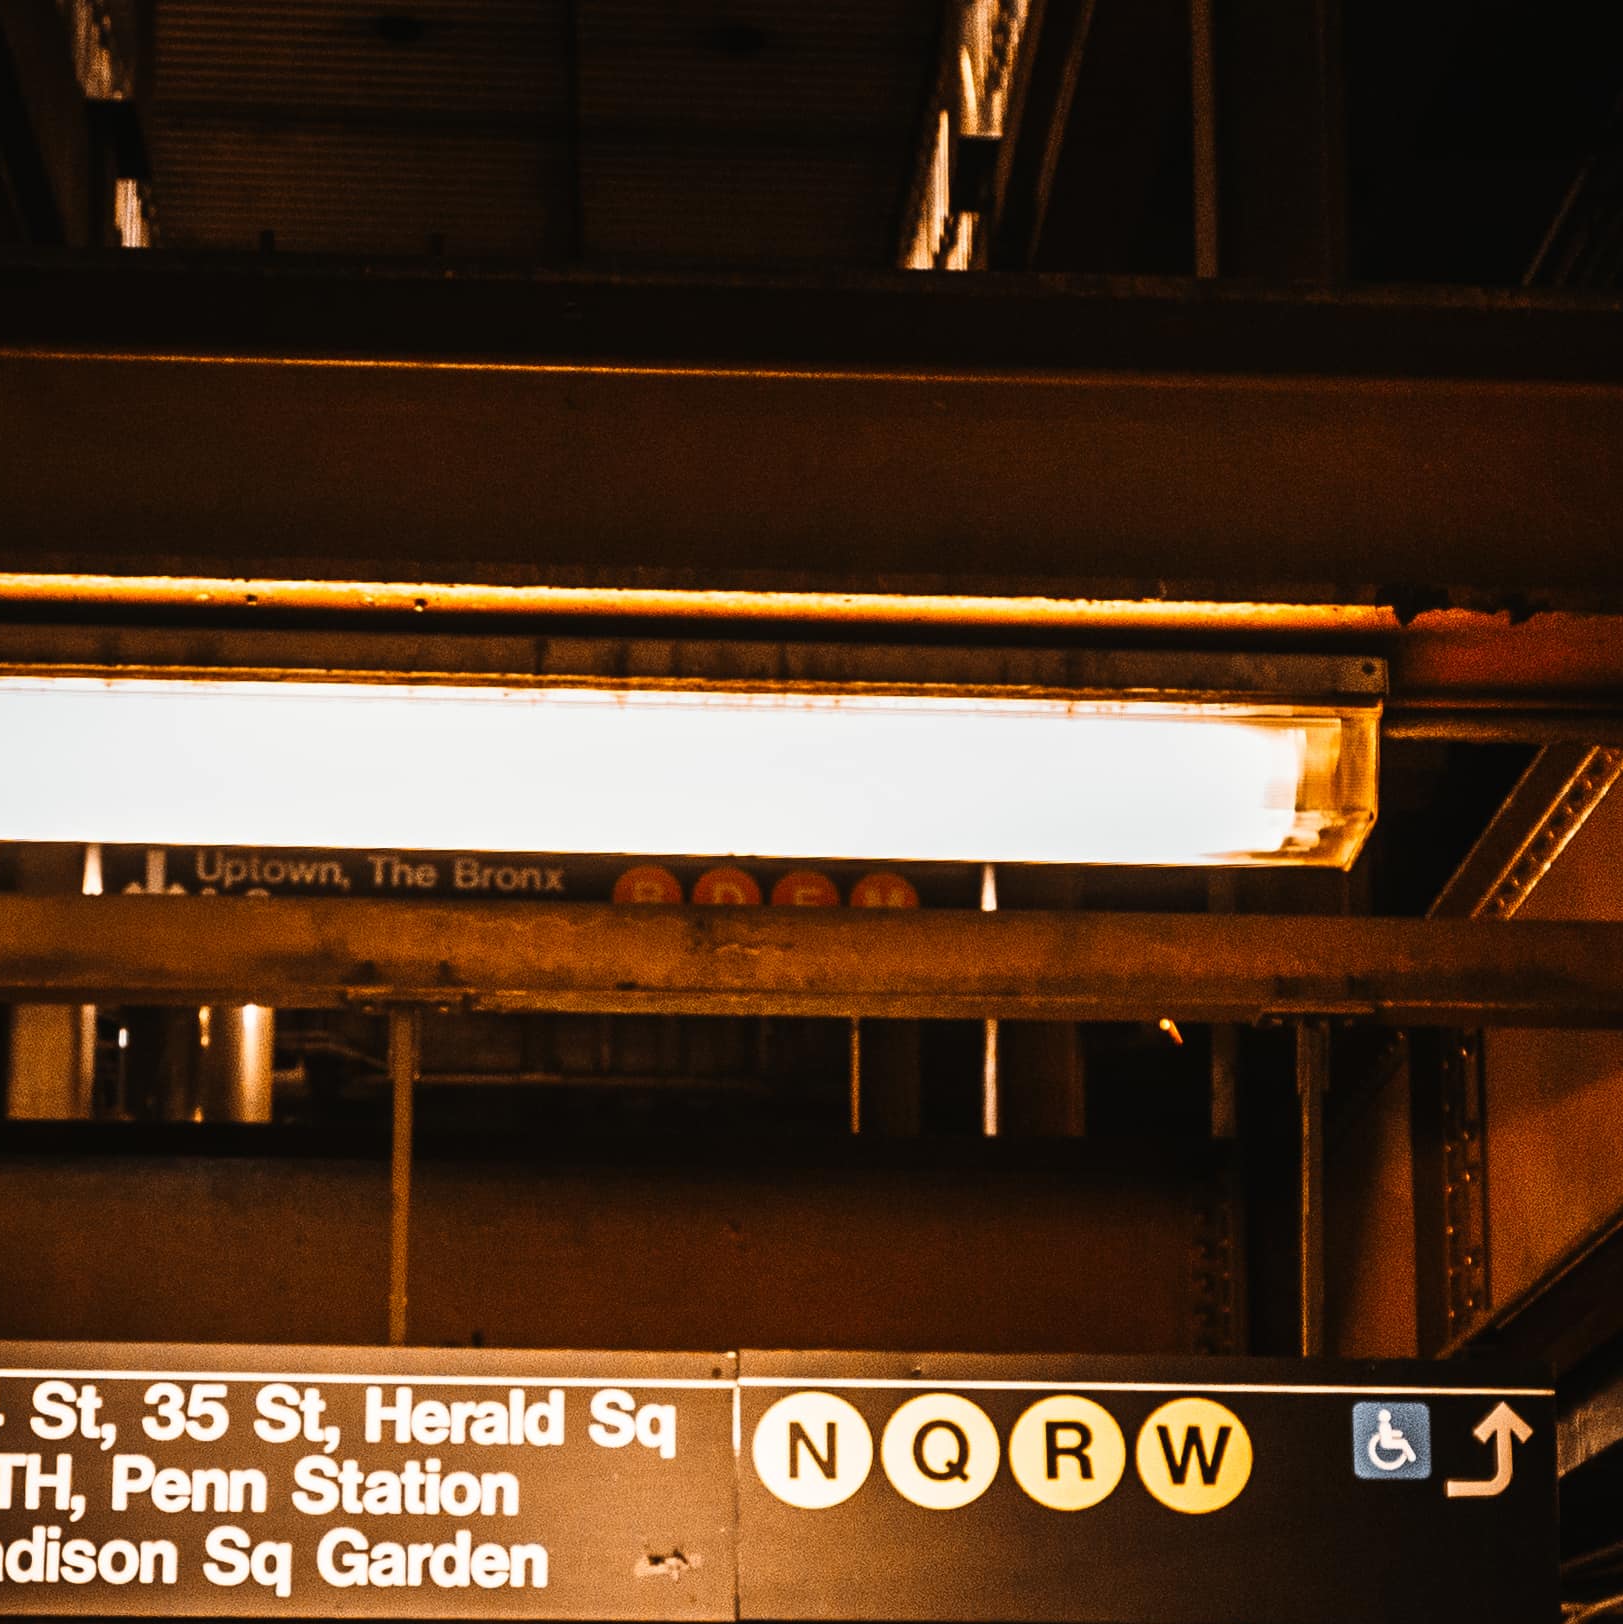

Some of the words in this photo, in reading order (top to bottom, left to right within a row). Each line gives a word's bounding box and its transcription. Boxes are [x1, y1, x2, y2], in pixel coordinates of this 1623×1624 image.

[194, 849, 352, 891] Uptown,
[368, 854, 440, 889] The
[453, 857, 567, 892] Bronx
[30, 1380, 117, 1451] St,
[141, 1382, 229, 1442] 35
[253, 1383, 340, 1455] St,
[364, 1386, 565, 1448] Herald
[588, 1389, 676, 1459] Sq
[788, 1421, 837, 1480] N
[912, 1419, 970, 1482] Q
[1045, 1420, 1094, 1481] R
[1156, 1424, 1233, 1486] W
[110, 1454, 268, 1514] Penn
[290, 1456, 519, 1517] Station
[202, 1525, 293, 1598] Sq
[316, 1527, 549, 1589] Garden
